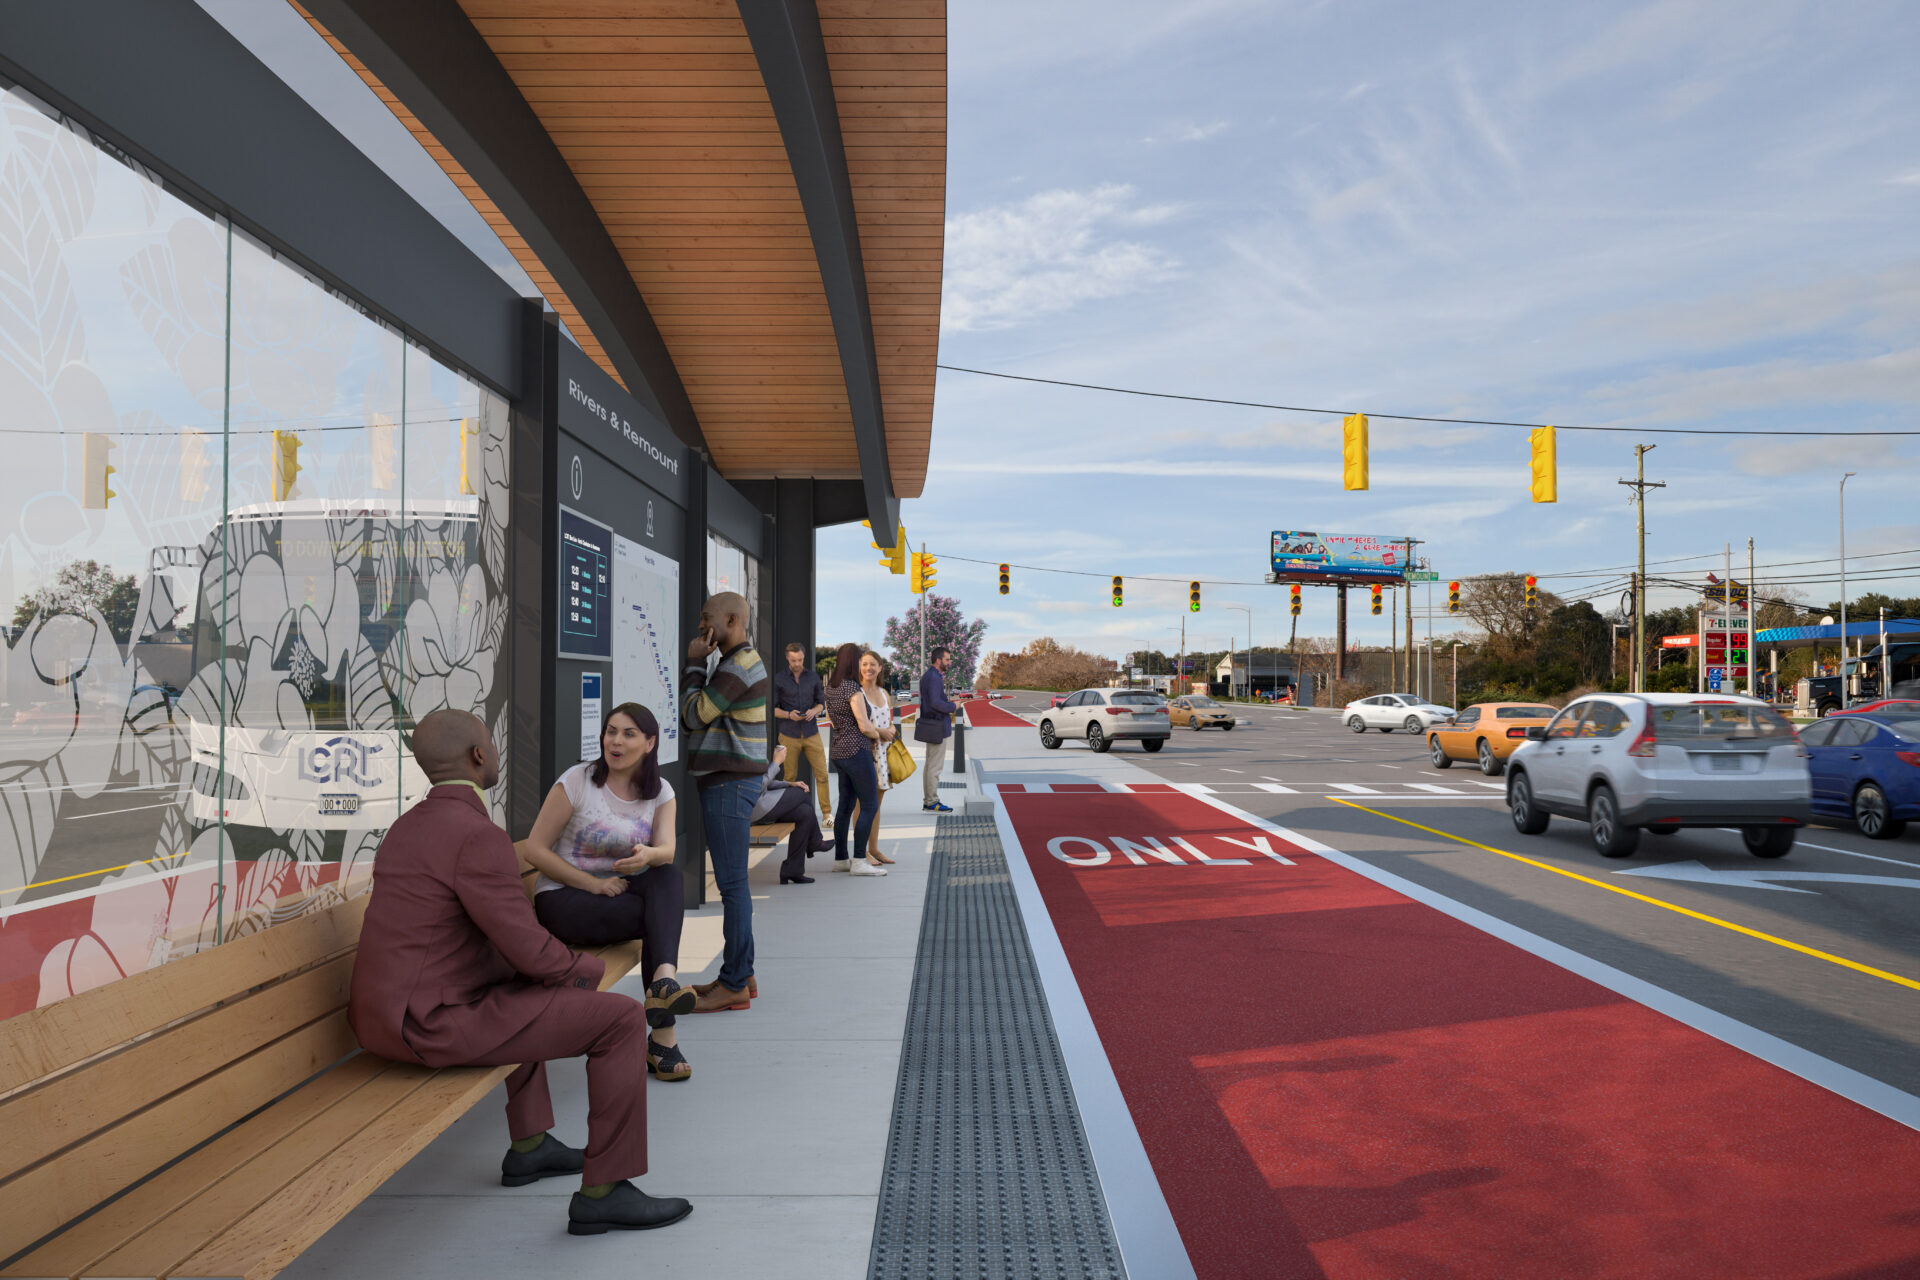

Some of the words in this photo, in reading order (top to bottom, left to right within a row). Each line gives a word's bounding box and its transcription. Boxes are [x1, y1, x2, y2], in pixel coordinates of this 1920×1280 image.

[568, 378, 607, 422] Rivers
[610, 411, 620, 431] &
[623, 420, 679, 476] Remount
[381, 540, 467, 558] CHARLESTON
[1403, 572, 1430, 581] REMOUN
[1724, 633, 1748, 648] 99
[298, 736, 384, 788] LCRT
[1047, 836, 1298, 866] ONLY
